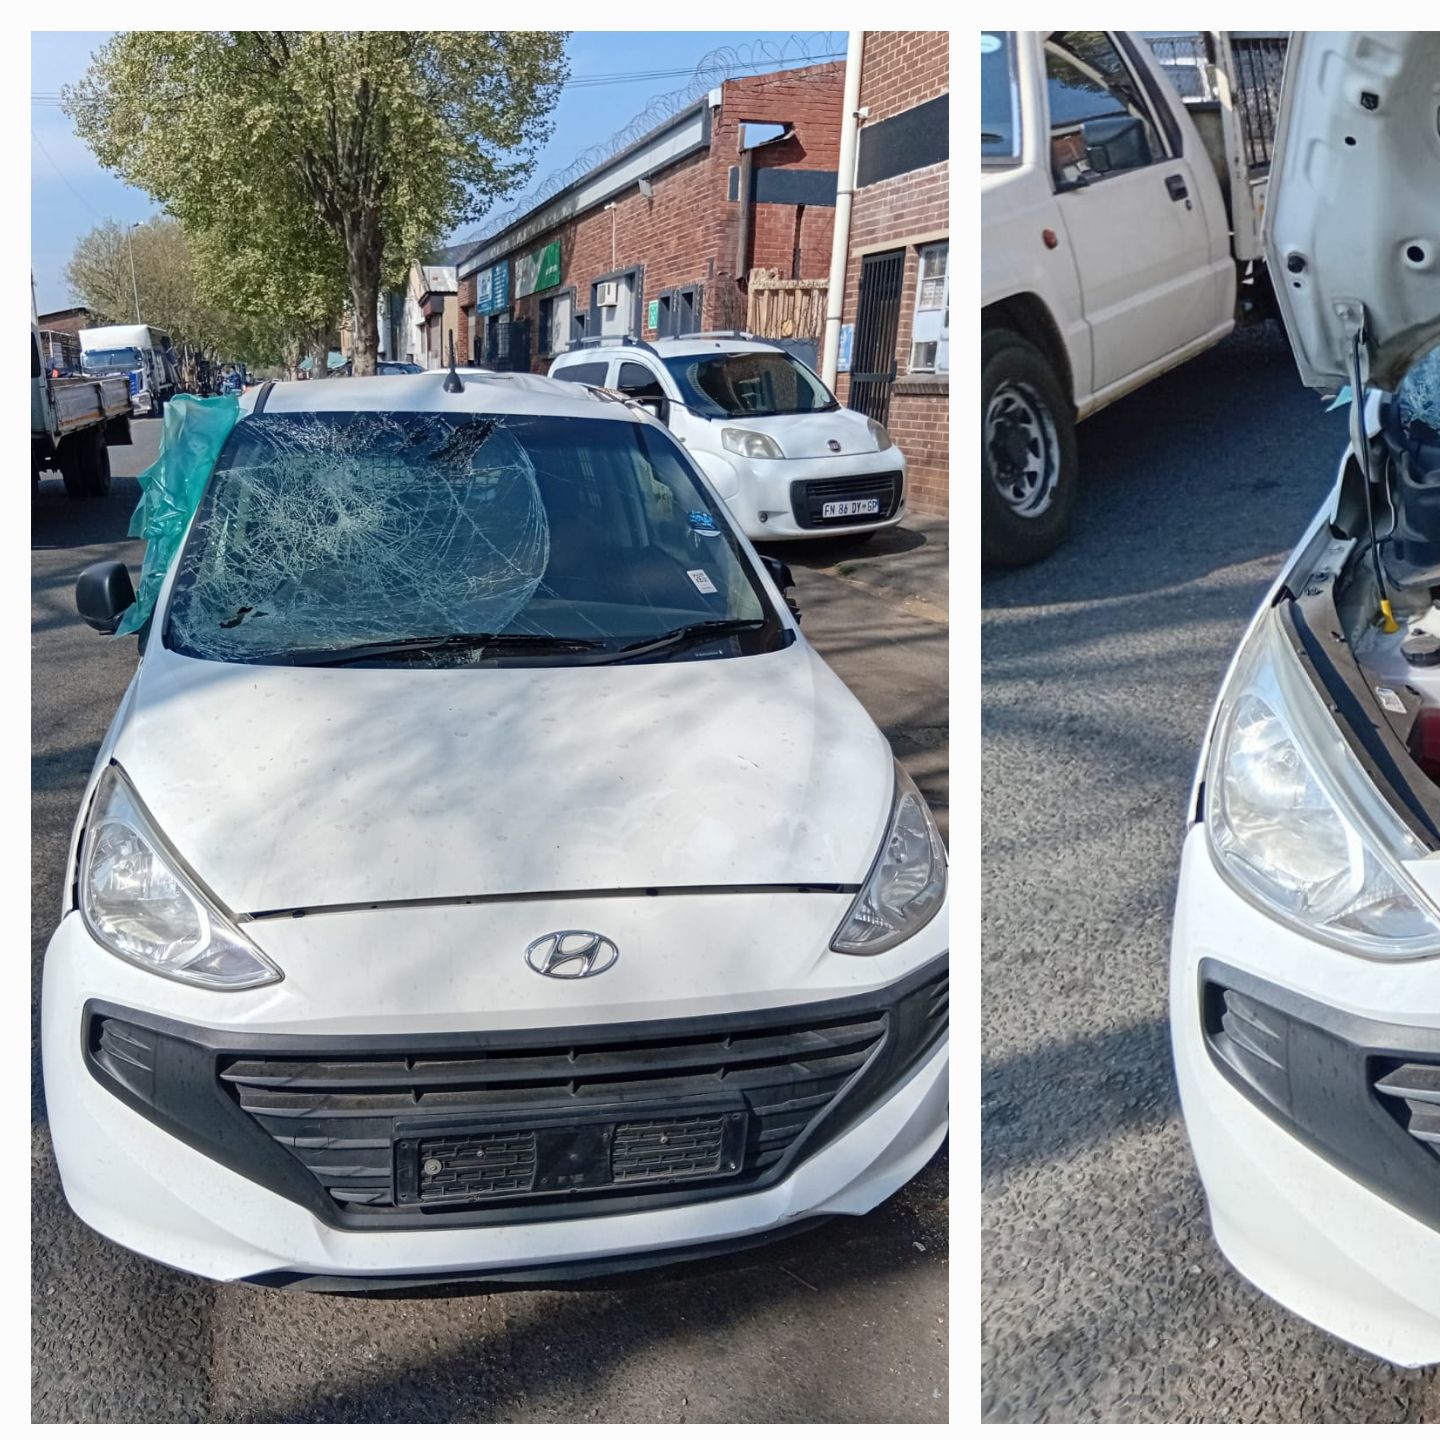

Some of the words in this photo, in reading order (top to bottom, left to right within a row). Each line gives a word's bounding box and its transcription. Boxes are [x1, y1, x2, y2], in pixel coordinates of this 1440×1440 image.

[824, 504, 835, 516] FN
[839, 502, 848, 515] 86
[868, 500, 877, 512] GP
